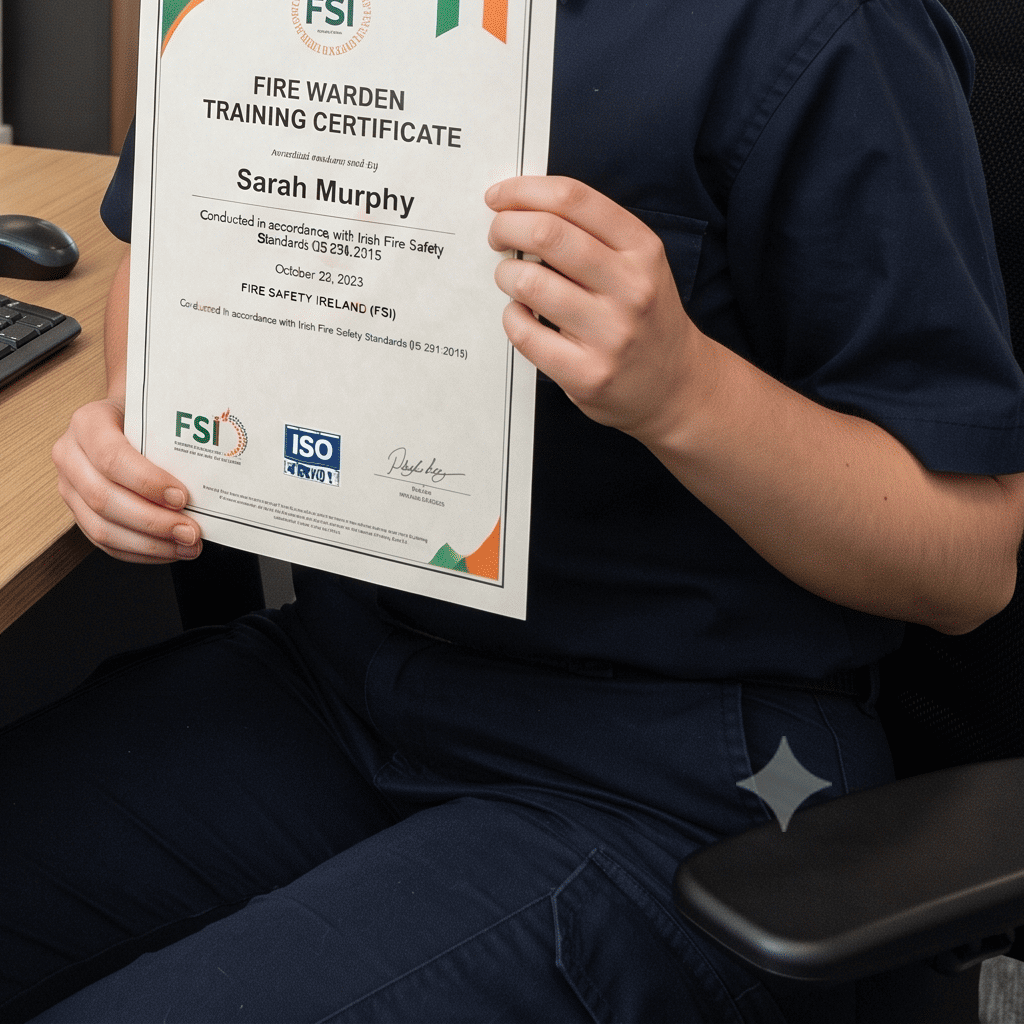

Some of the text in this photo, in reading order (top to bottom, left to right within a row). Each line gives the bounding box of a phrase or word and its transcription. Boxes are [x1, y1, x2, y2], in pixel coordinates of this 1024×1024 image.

[253, 75, 406, 111] FIRE WARDEN
[203, 98, 462, 148] TRAINING CERTIFICATE
[236, 167, 415, 219] Sarah Murphy
[200, 209, 254, 227] Conducted
[257, 218, 266, 229] in
[358, 232, 380, 246] Irish
[384, 236, 405, 249] Fire
[409, 239, 444, 259] Safety
[257, 232, 309, 251] Standards
[337, 273, 364, 287] 2023
[241, 283, 396, 321] FIRE SAFETY IRELAND (FSI)
[231, 310, 277, 324] accordance
[279, 318, 296, 328] with
[298, 320, 316, 332] Irish
[318, 324, 334, 334] Fire
[365, 332, 408, 348] Standards
[175, 411, 220, 447] FSI
[292, 433, 333, 461] ISO
